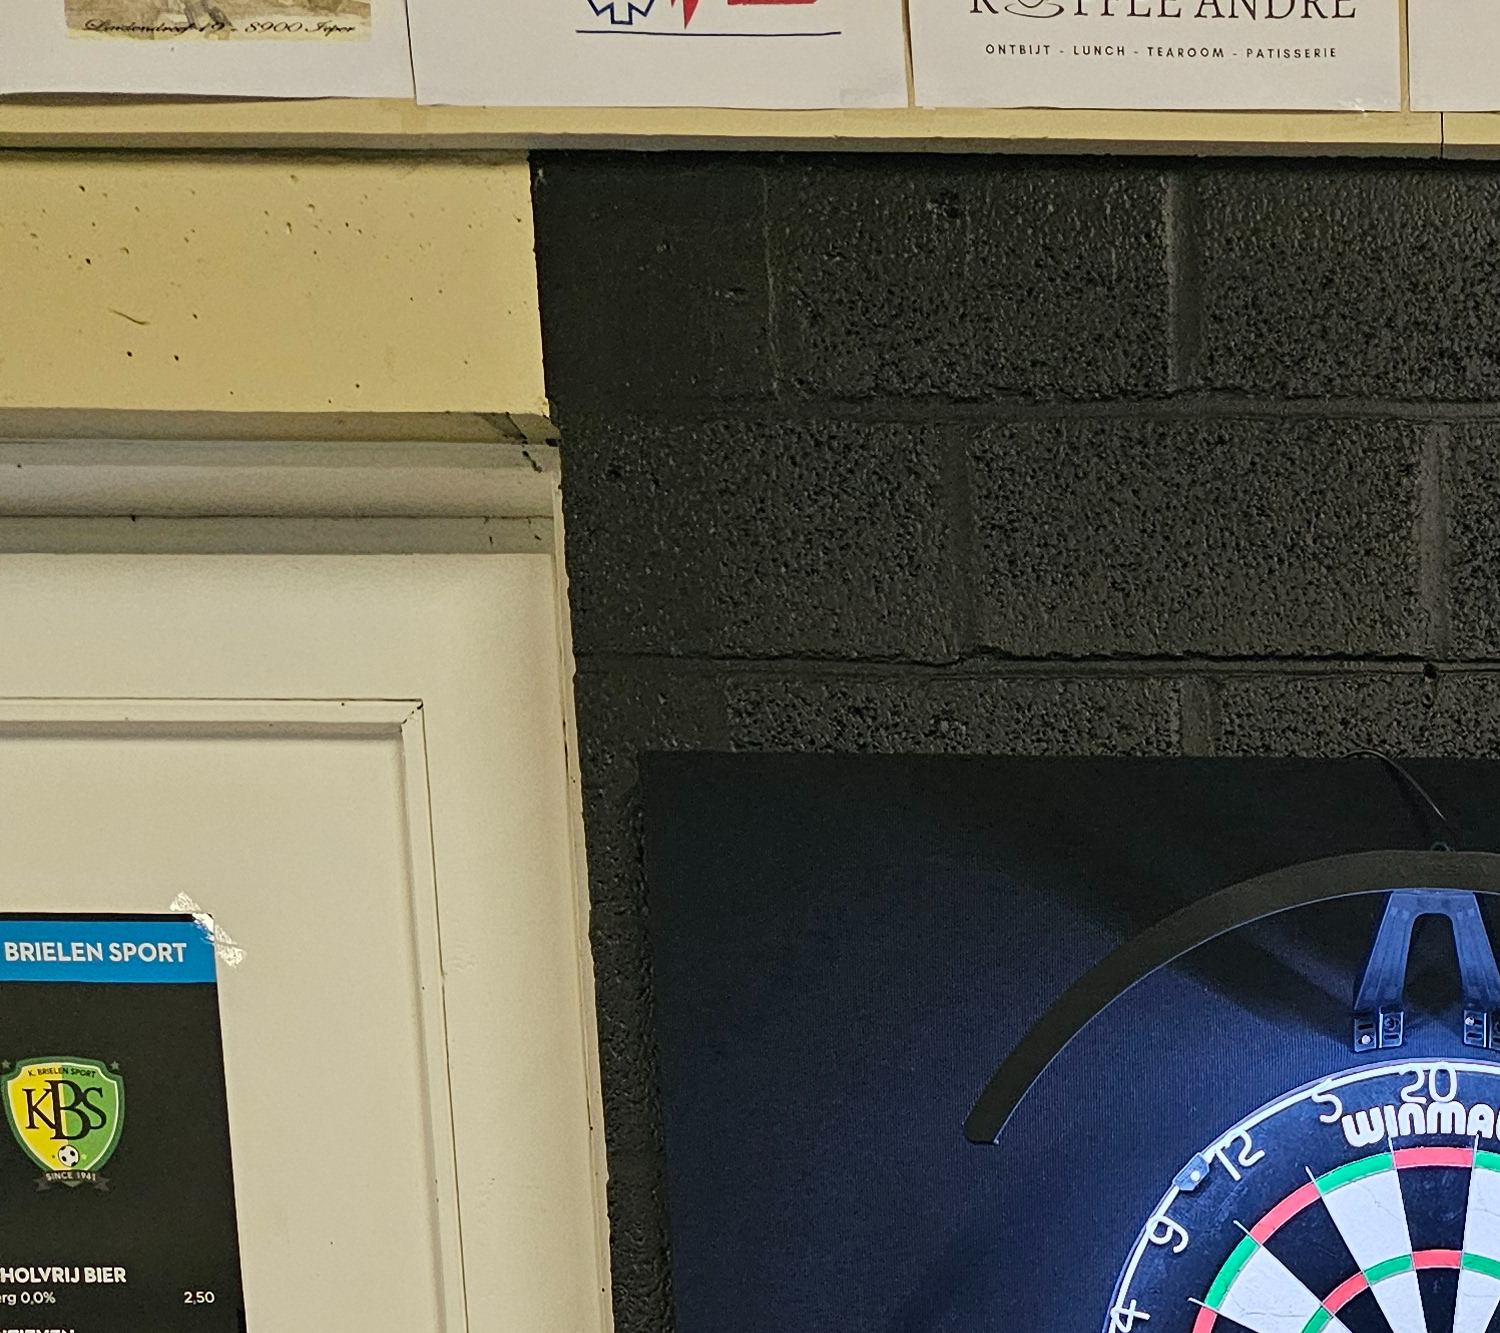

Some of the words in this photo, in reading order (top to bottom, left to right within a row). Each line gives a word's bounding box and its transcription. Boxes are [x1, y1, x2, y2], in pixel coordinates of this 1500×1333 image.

[245, 22, 303, 33] 8900
[986, 44, 1051, 55] ONTBIJT
[1073, 45, 1126, 56] LUNCH
[1147, 46, 1224, 58] TEAROOM
[1246, 47, 1337, 59] PATISSERIE
[4, 941, 103, 962] BRIELEN
[109, 941, 187, 962] SPORT
[37, 1067, 68, 1076] BRIELEN
[71, 1068, 96, 1078] SPORT
[1398, 1063, 1457, 1103] 20
[1311, 1078, 1343, 1123] 5
[22, 1080, 107, 1140] KBS
[1207, 1130, 1265, 1181] 12
[45, 1172, 73, 1181] SINCE
[76, 1171, 96, 1181] 1941
[1146, 1216, 1189, 1253] 9
[84, 1267, 126, 1283] BIER
[184, 1291, 215, 1305] 2,50
